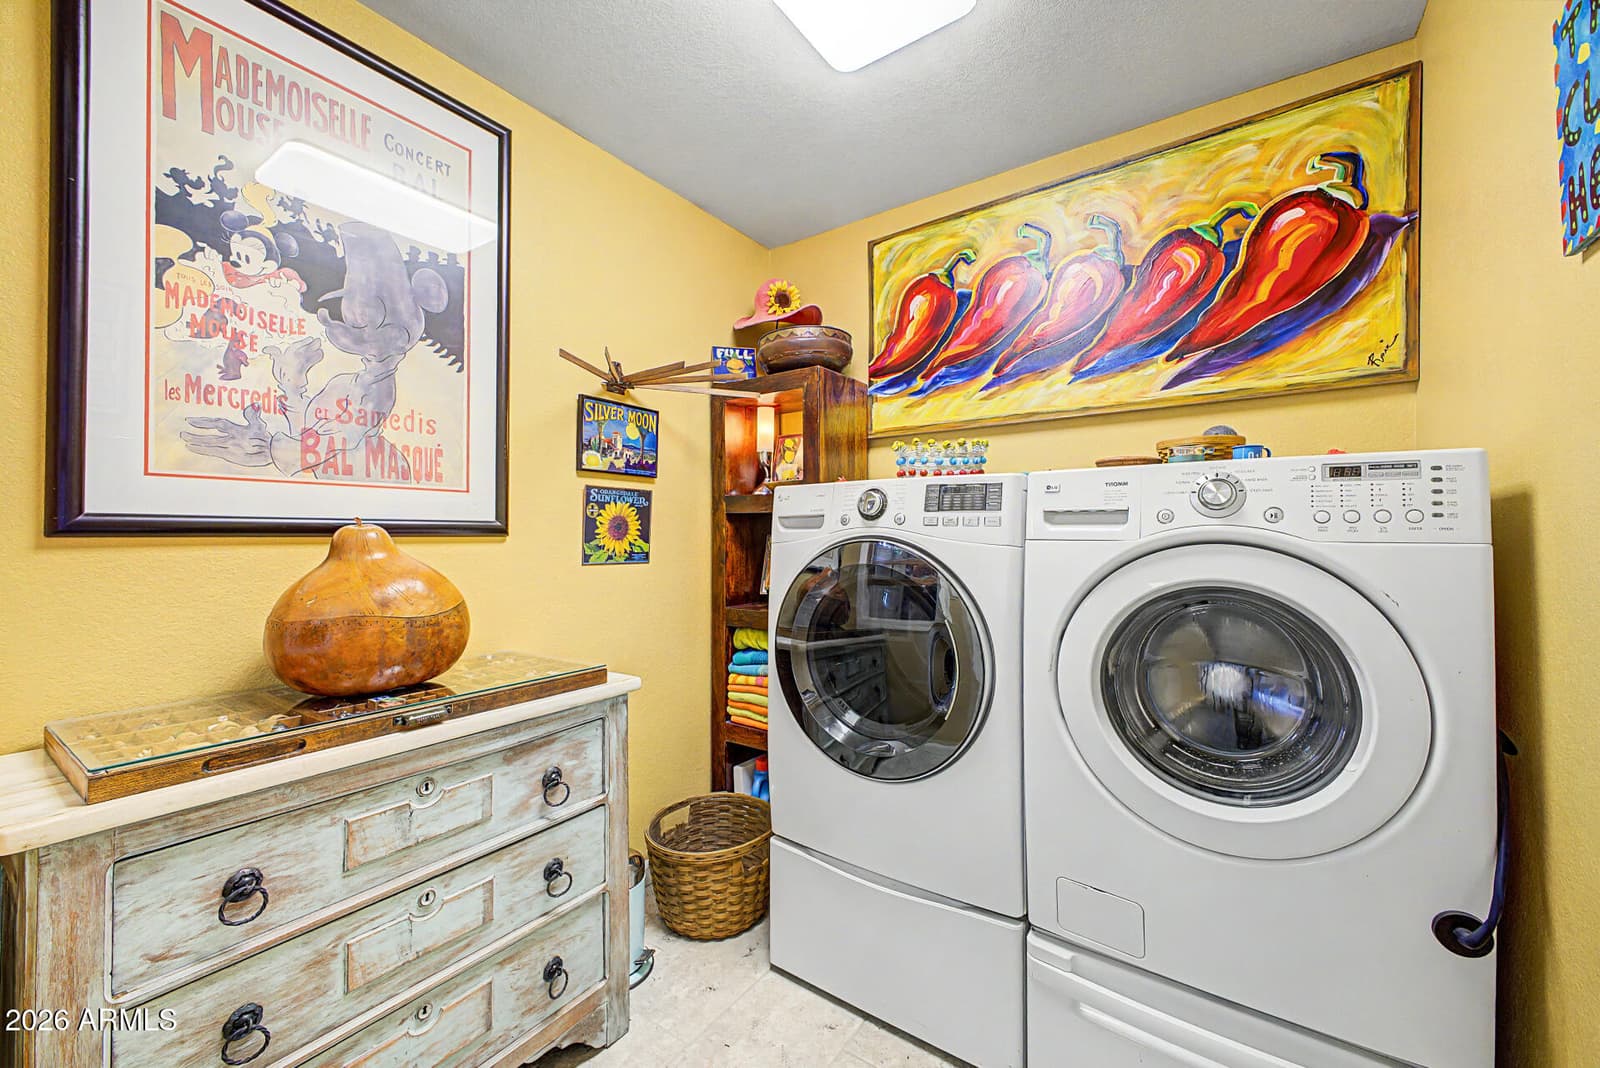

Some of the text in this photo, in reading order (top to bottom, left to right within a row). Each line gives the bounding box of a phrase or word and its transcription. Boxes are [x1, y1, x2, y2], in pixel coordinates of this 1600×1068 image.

[160, 10, 371, 149] MADEMOISELLE
[384, 133, 451, 177] CONCERT
[165, 280, 306, 335] MADEMOISELLE
[190, 313, 258, 352] MOUSE
[716, 348, 752, 359] FULL
[164, 378, 182, 402] les
[184, 373, 288, 416] Mercredis
[335, 397, 437, 435] Samedis
[585, 402, 657, 436] SILVER MOON
[300, 427, 353, 477] BAL
[590, 488, 649, 506] SUNFLOWER
